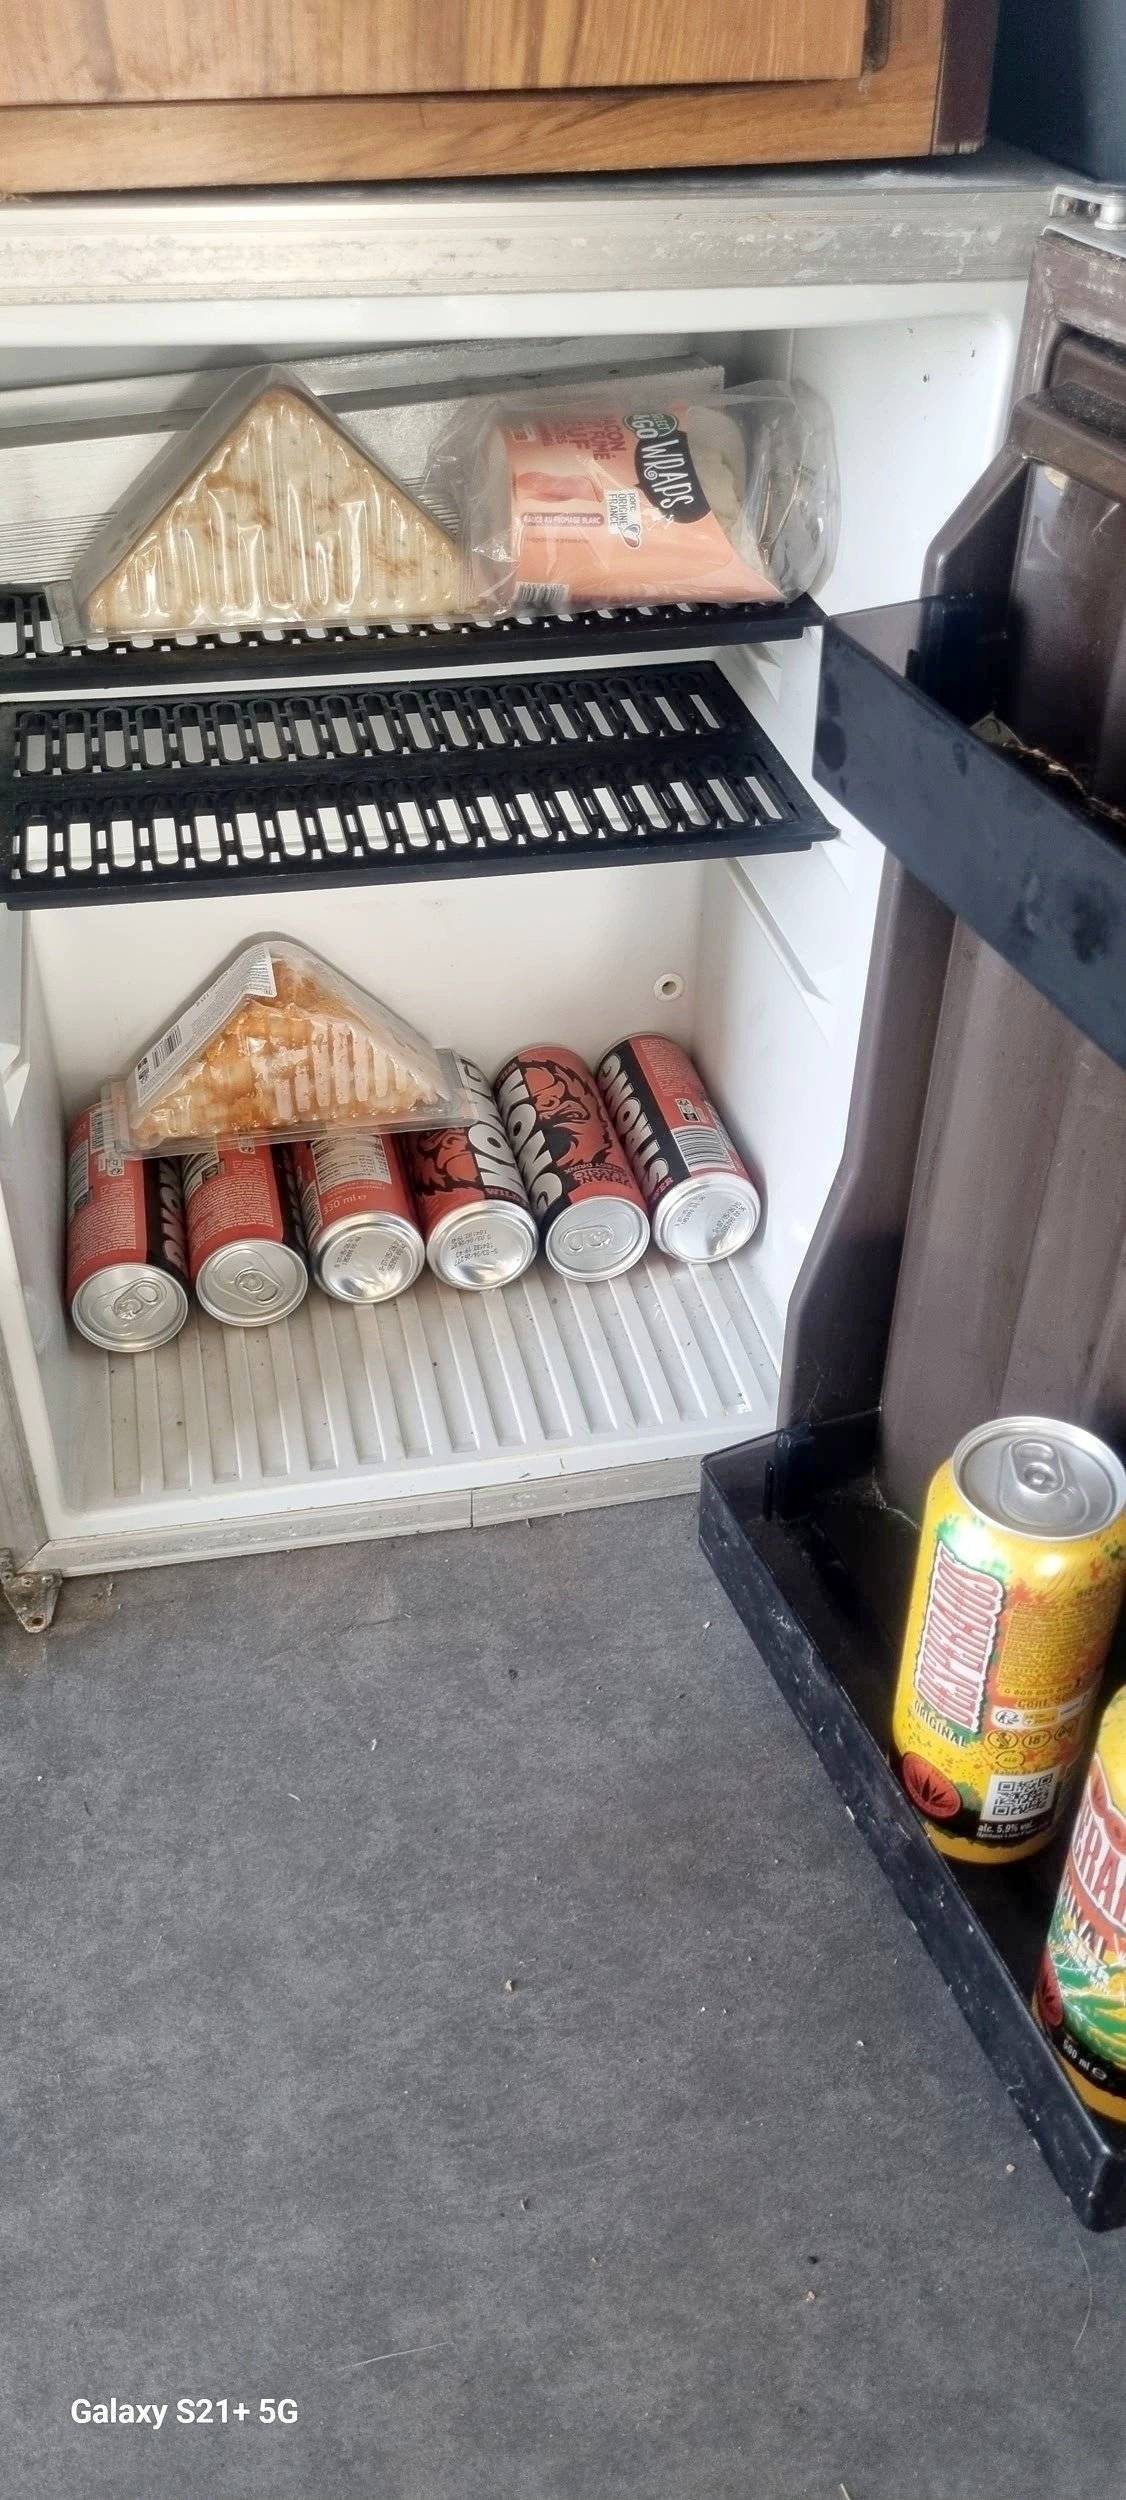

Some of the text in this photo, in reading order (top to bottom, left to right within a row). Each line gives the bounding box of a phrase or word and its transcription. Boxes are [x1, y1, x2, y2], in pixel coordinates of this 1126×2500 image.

[641, 439, 695, 509] WRAPS
[608, 494, 618, 527] FRANCE
[618, 493, 628, 526] ORIGINE
[914, 1702, 968, 1748] ORIGINAL
